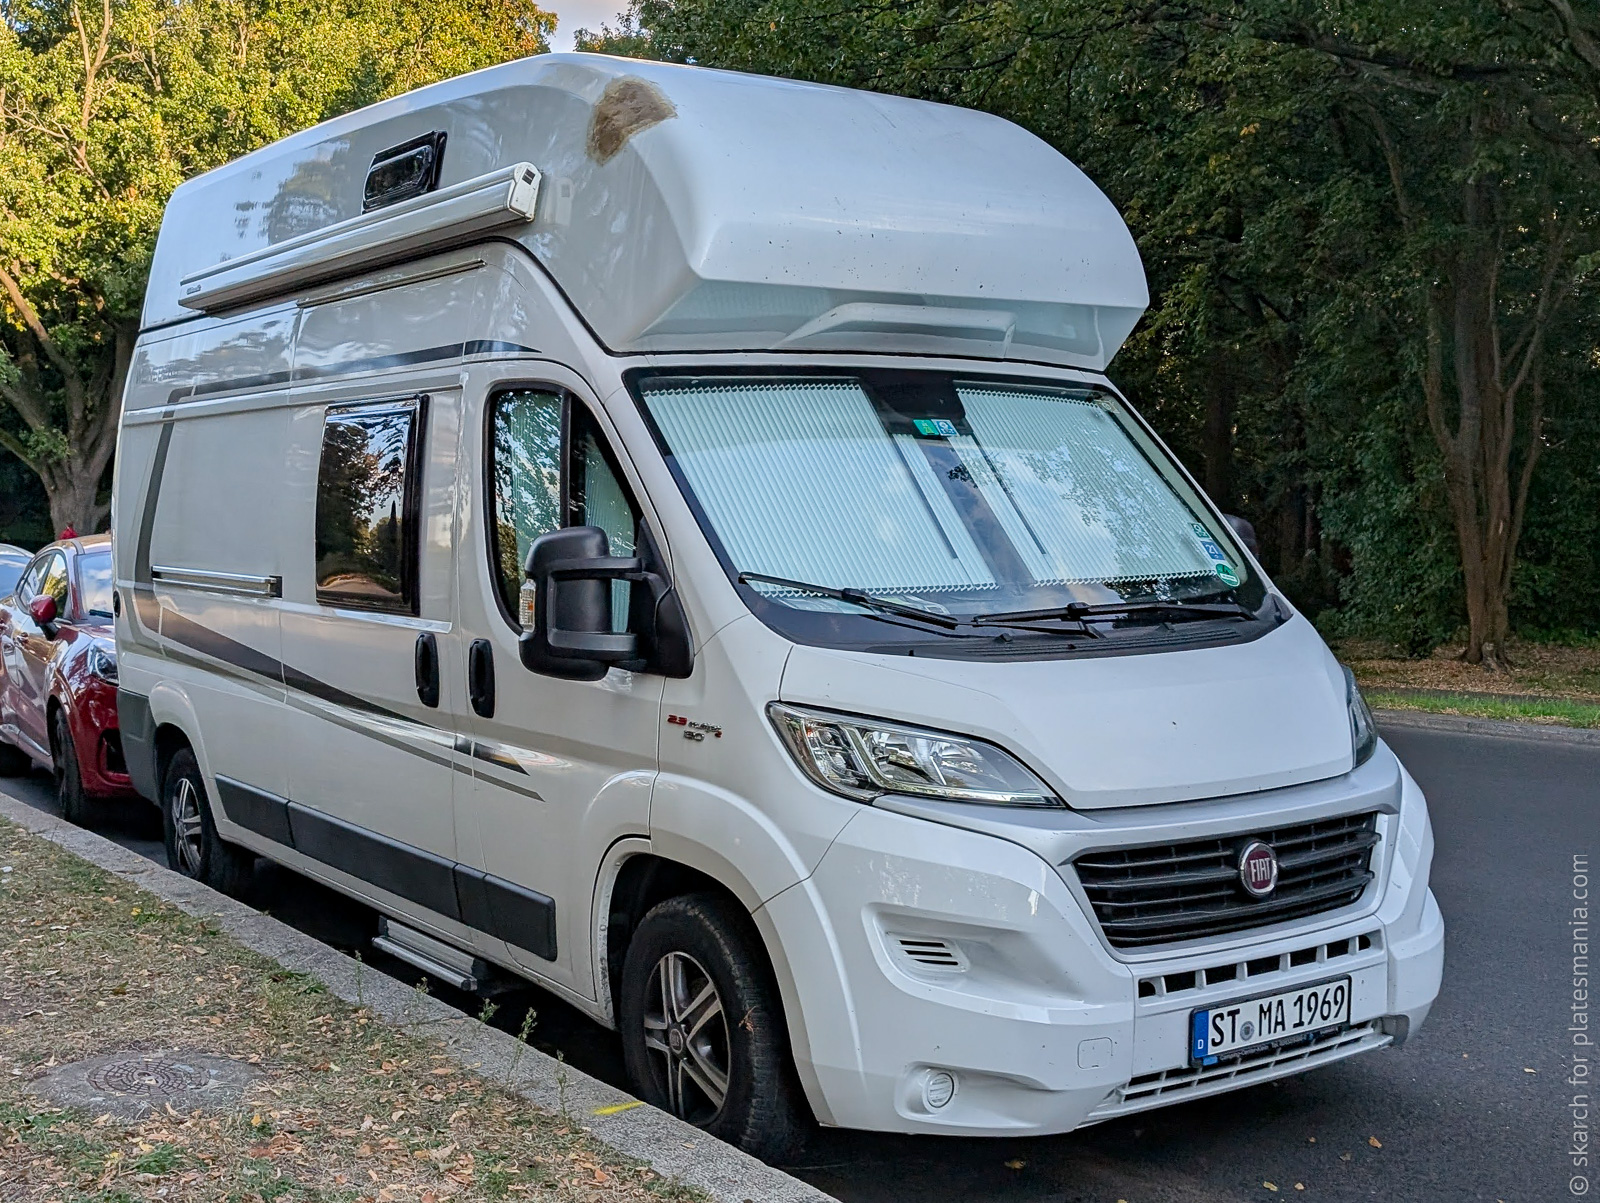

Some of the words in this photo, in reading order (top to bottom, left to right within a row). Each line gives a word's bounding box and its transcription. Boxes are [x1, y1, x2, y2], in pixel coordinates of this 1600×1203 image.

[1249, 857, 1271, 883] FIAT
[1210, 1008, 1241, 1047] ST
[1258, 999, 1286, 1037] MA
[1292, 984, 1346, 1029] 1969
[1197, 1039, 1204, 1050] D
